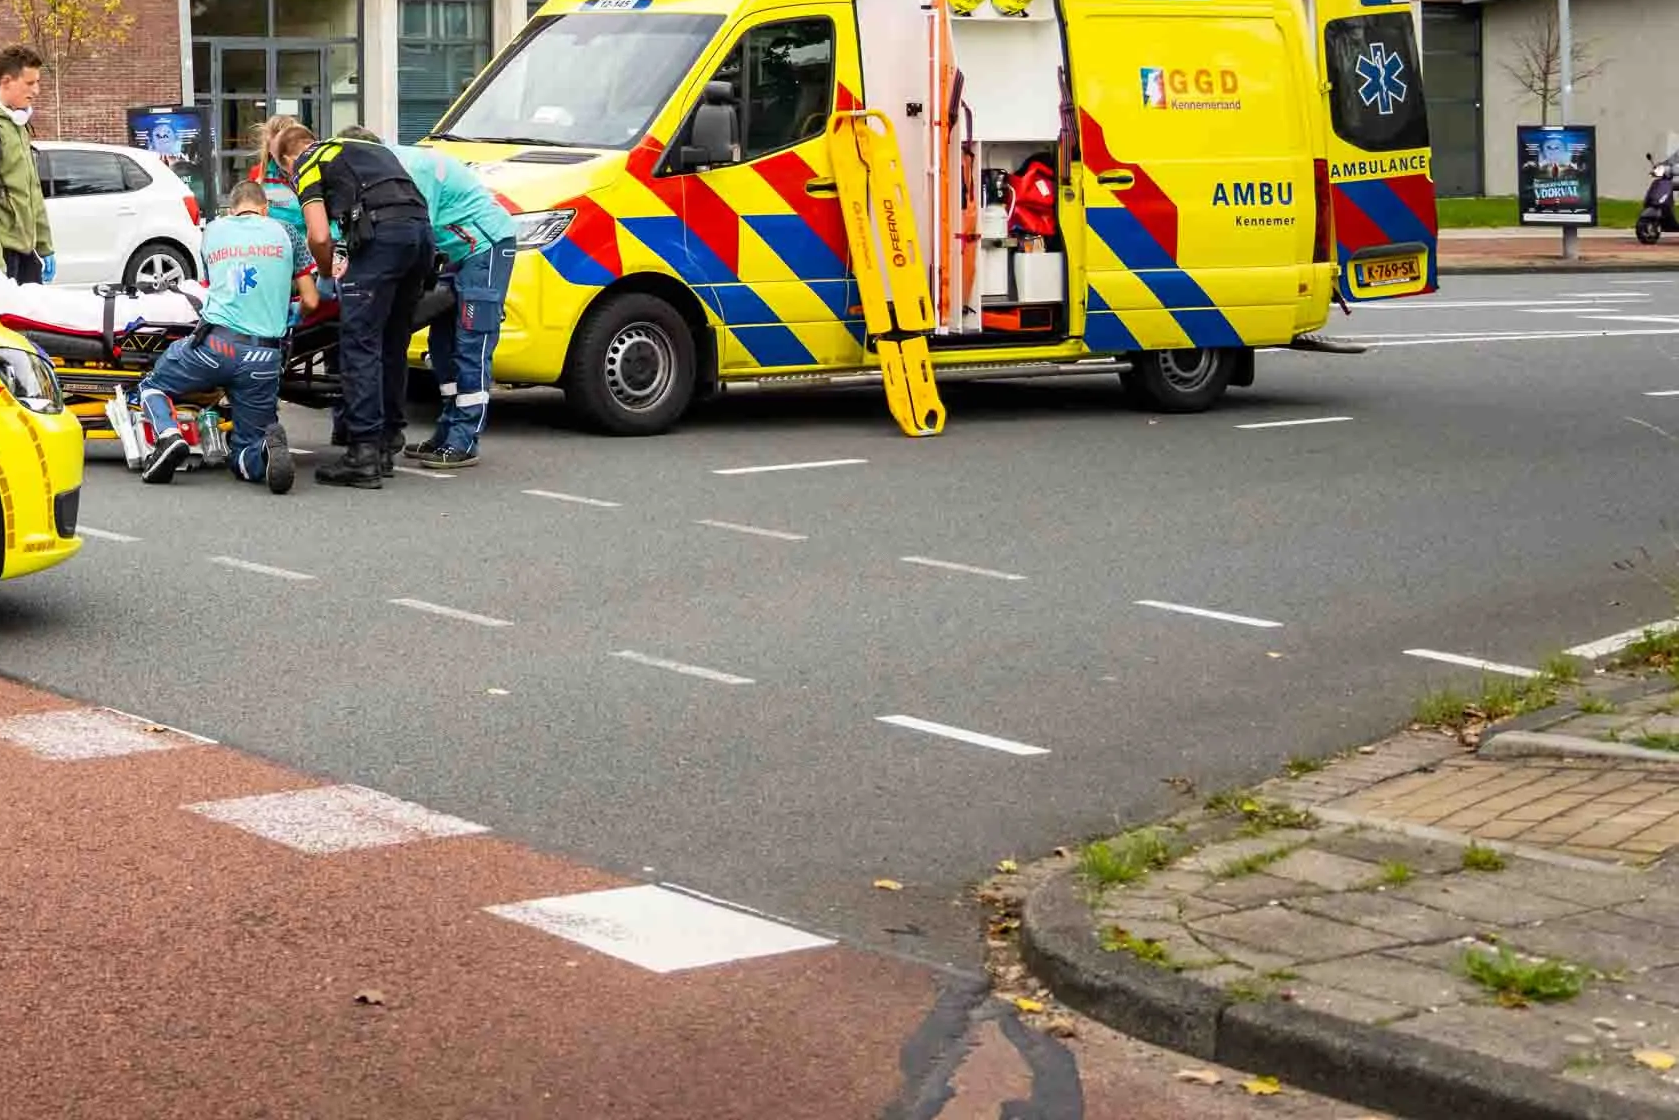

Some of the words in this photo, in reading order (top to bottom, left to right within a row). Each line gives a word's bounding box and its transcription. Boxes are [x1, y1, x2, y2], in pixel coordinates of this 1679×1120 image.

[1169, 69, 1239, 95] GGD
[1171, 99, 1241, 111] Kennemerland
[1330, 155, 1426, 179] AMBULANCE
[1212, 181, 1294, 206] AMBU
[1235, 215, 1296, 227] Kennemer
[207, 243, 284, 265] AMBULANCE
[1367, 260, 1418, 280] K-769-SK
